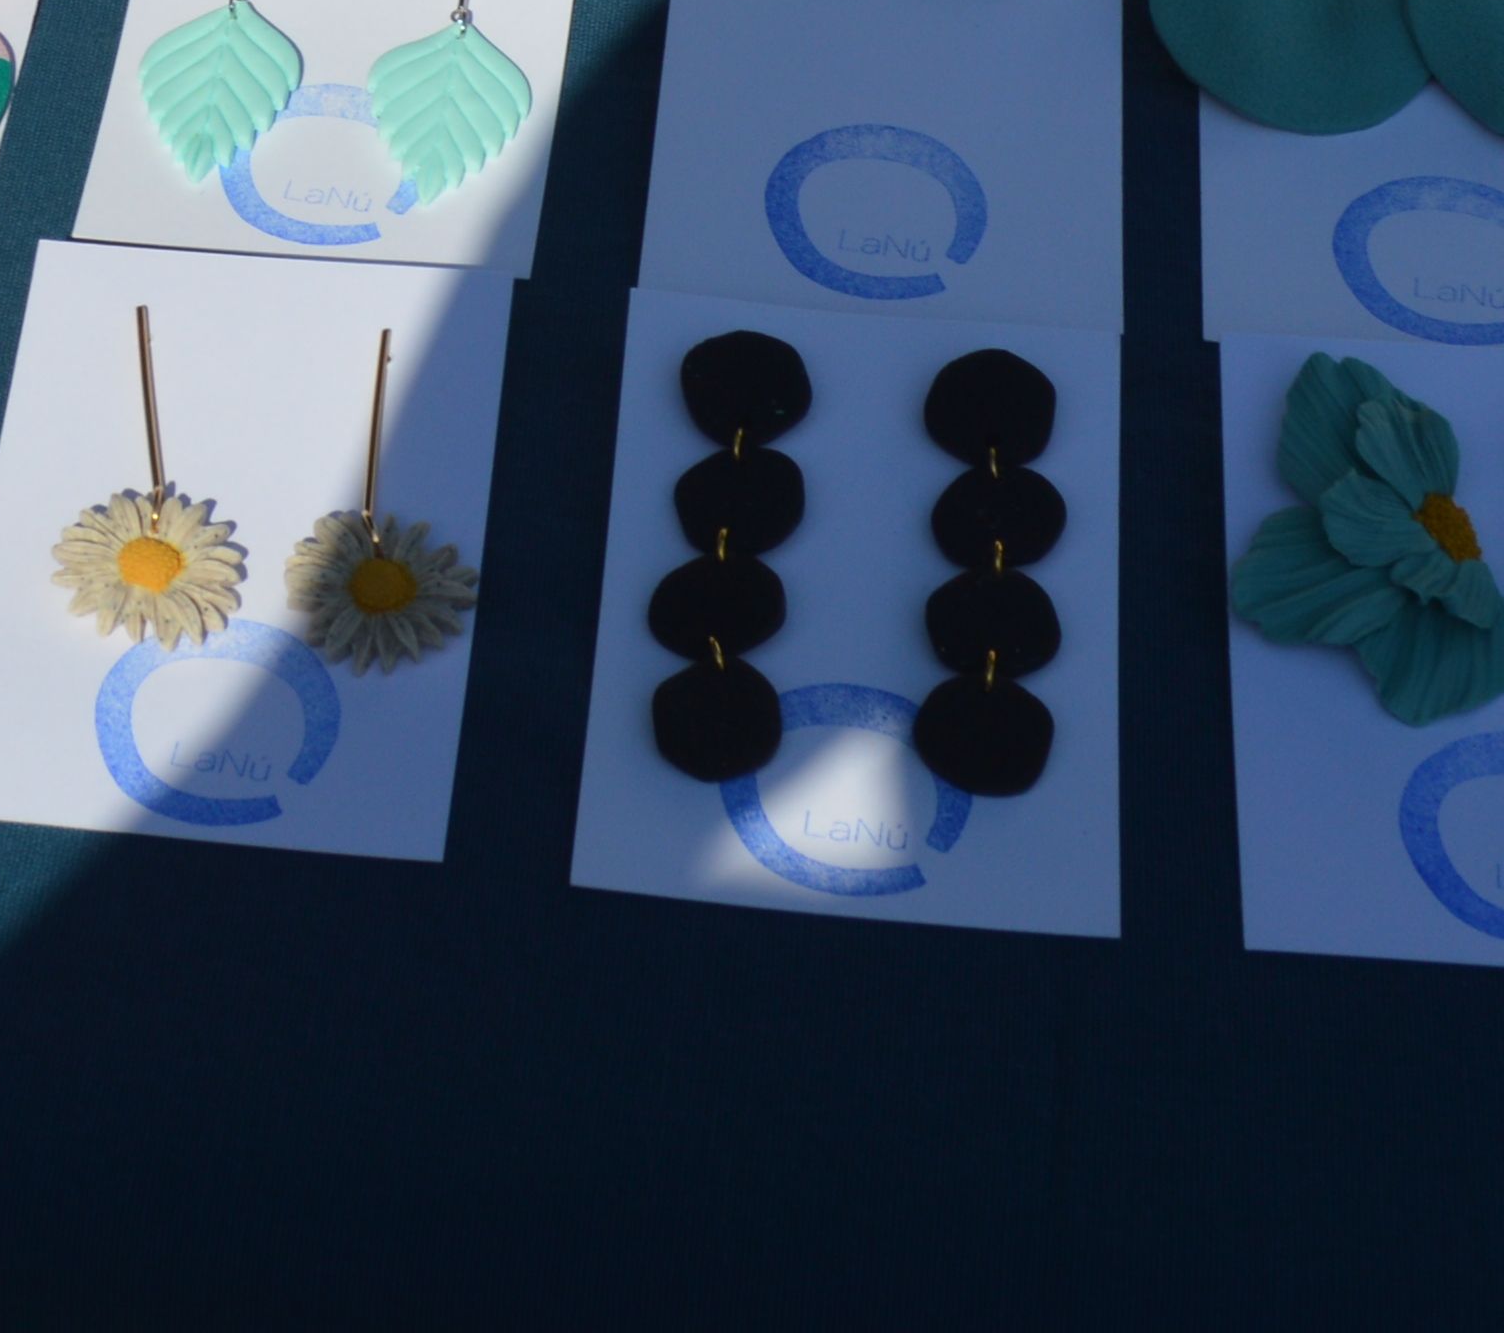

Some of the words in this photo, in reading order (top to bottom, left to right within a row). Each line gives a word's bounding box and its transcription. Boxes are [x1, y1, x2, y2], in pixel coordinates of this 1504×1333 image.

[285, 181, 371, 212] LaNú
[838, 230, 930, 261] LaNú
[170, 744, 270, 782] LaNú
[804, 812, 906, 850] LaNú
